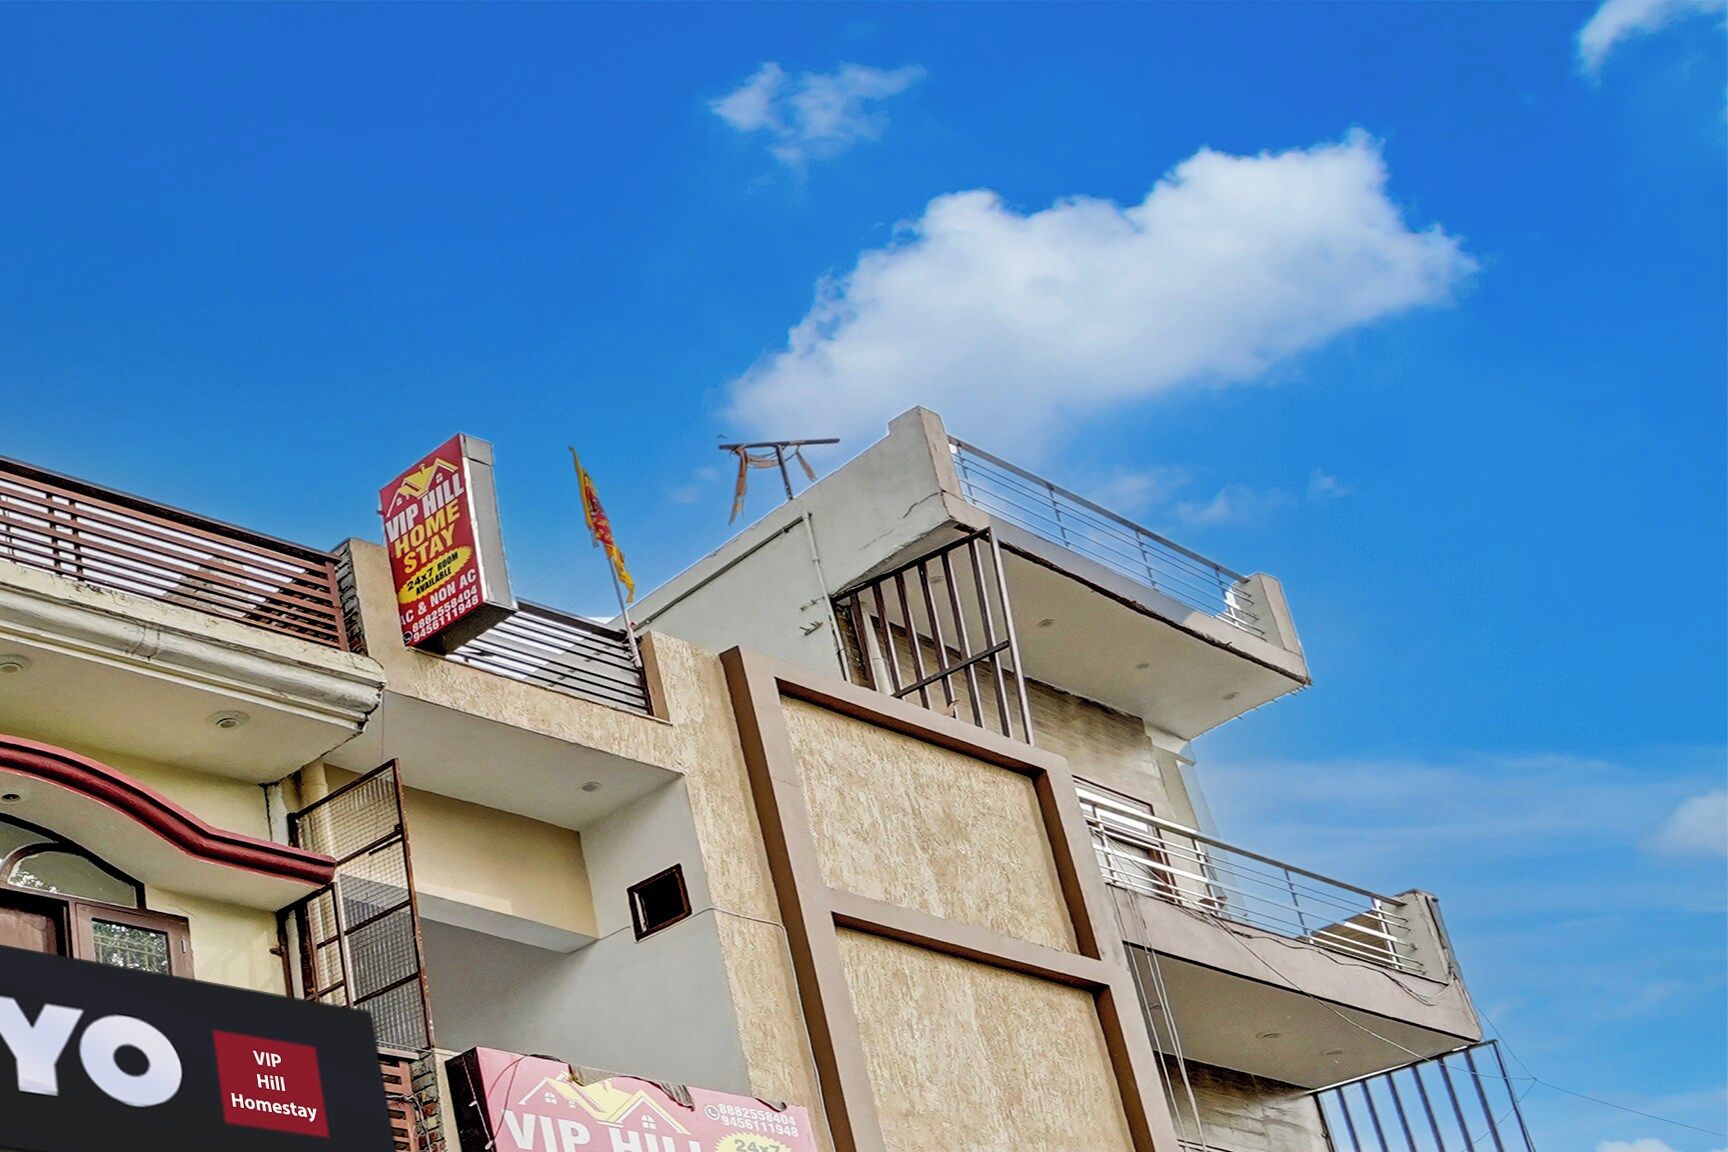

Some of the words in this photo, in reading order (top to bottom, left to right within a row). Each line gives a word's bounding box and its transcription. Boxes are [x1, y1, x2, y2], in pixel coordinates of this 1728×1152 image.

[385, 503, 419, 543] VIP
[421, 472, 464, 519] HILL
[394, 498, 461, 559] HOME
[403, 523, 455, 574] STAY
[407, 567, 434, 591] 24x7
[437, 551, 459, 570] ROOM
[416, 566, 452, 595] AVAILABLE
[417, 601, 427, 616] &
[430, 581, 456, 607] NON
[459, 568, 477, 589] AC
[252, 1050, 282, 1068] VIP
[256, 1073, 286, 1092] Hill
[230, 1092, 317, 1122] Homestay
[718, 1103, 796, 1126] 8882558404
[720, 1115, 799, 1138] 9456111948
